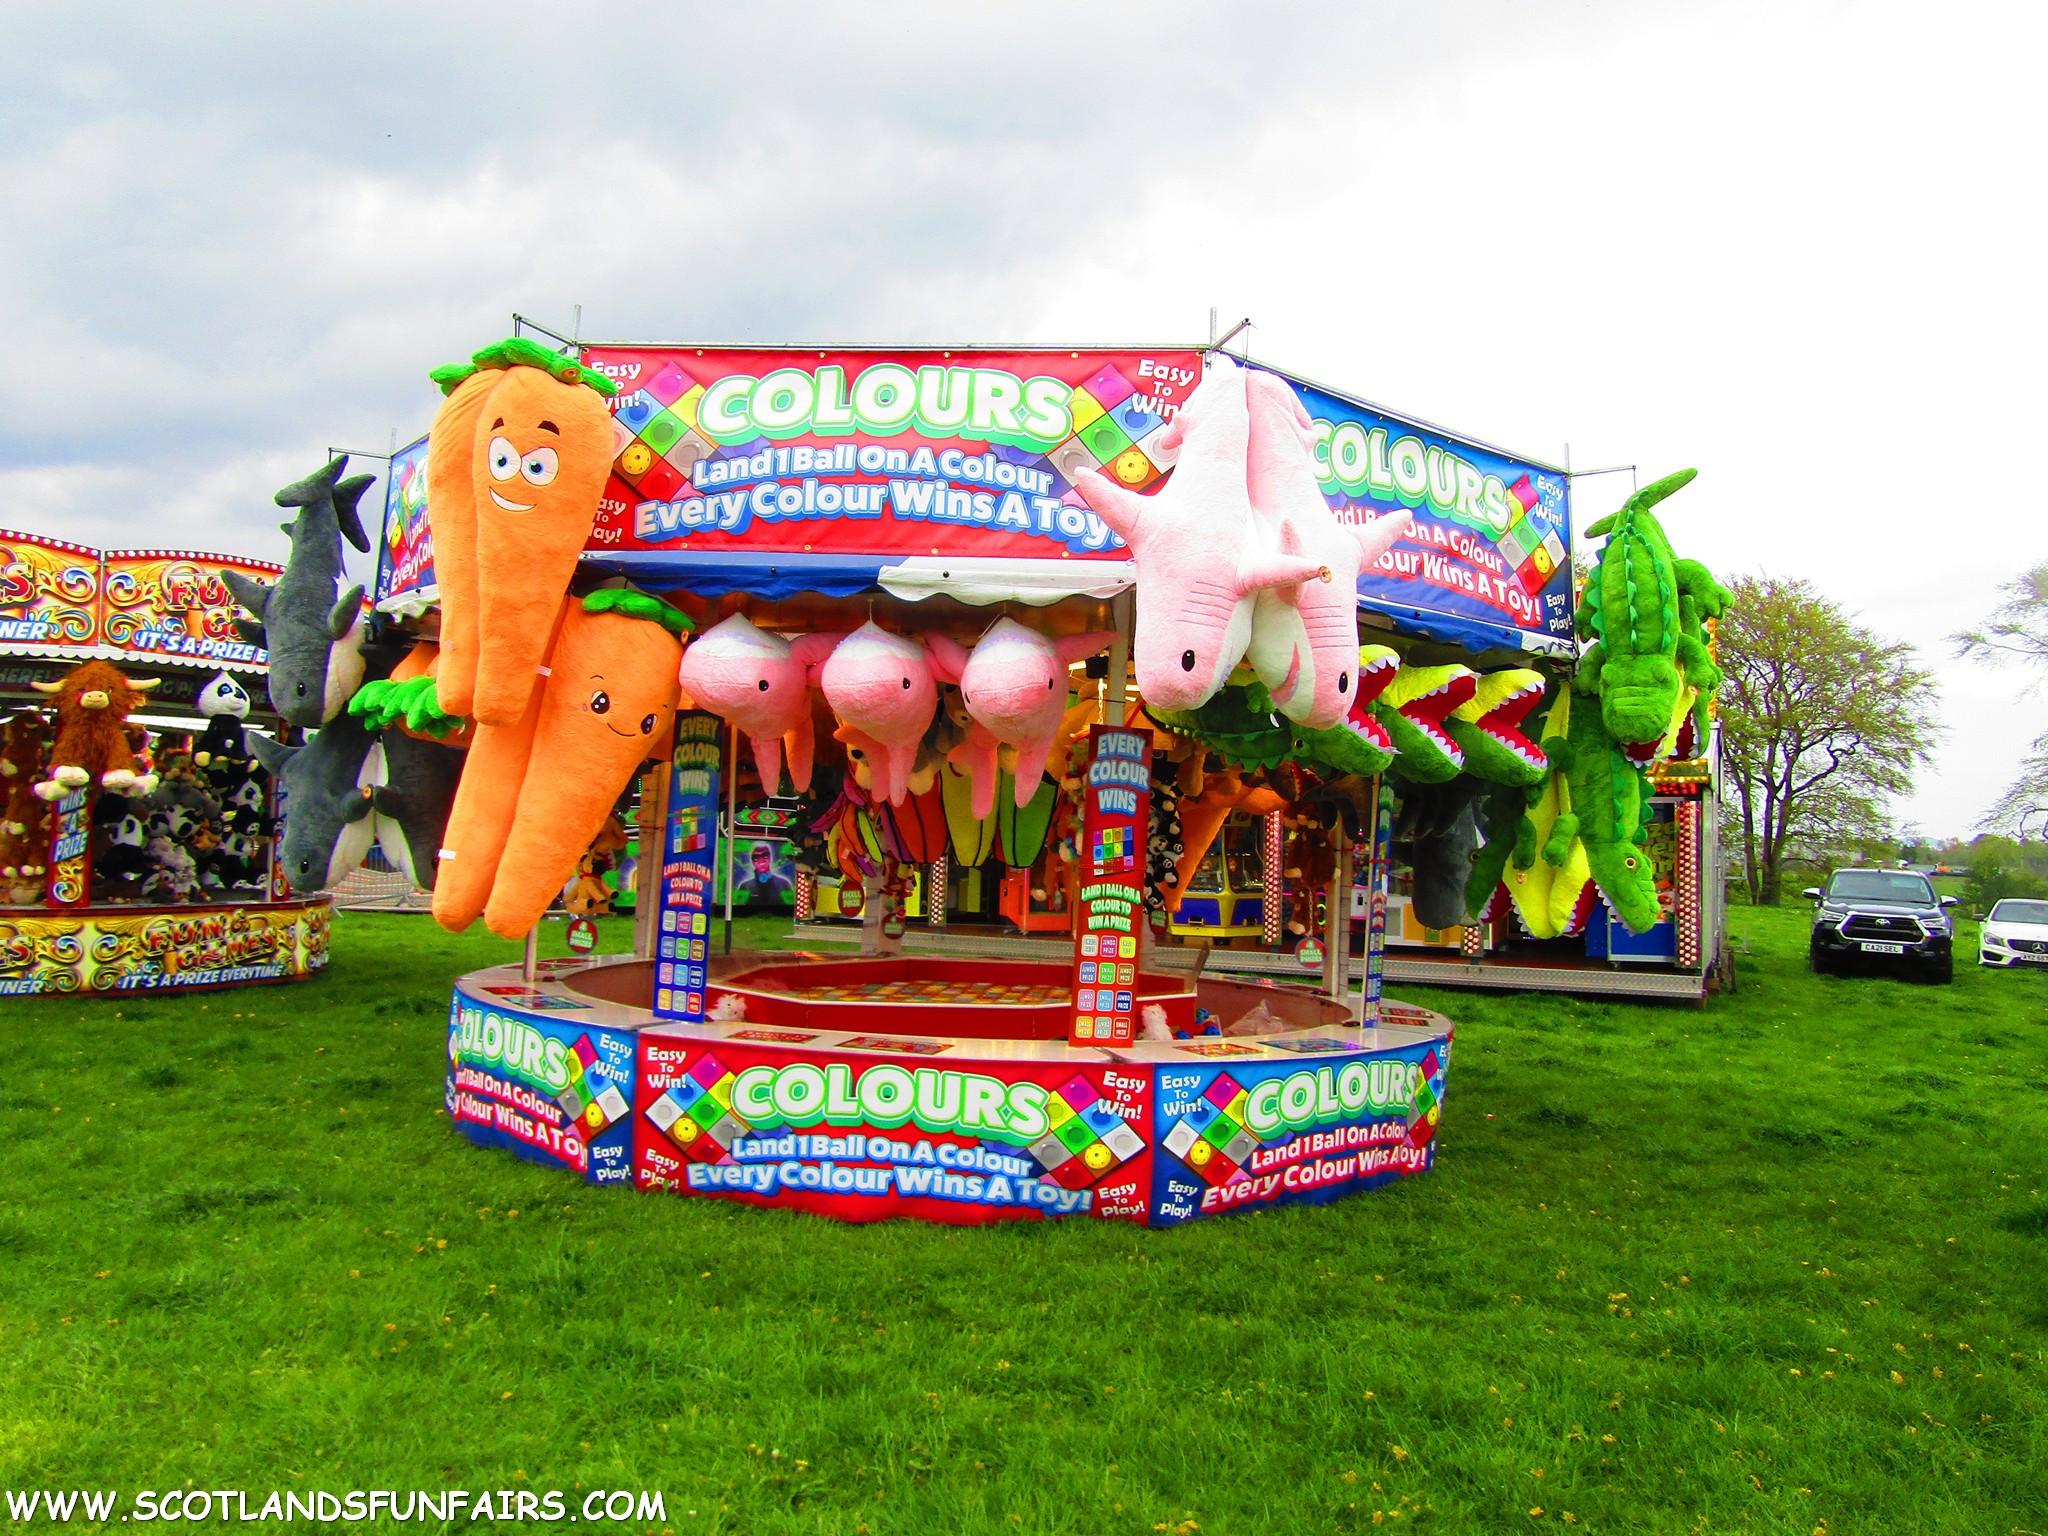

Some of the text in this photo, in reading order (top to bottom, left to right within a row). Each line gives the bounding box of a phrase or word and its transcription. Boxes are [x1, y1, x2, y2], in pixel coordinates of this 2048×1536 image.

[1138, 359, 1194, 387] Easy
[1153, 381, 1172, 396] To
[698, 363, 1073, 442] COLOURS
[1132, 393, 1184, 417] Win
[695, 445, 1053, 496] Land 1 Ball On A Colour
[1312, 419, 1510, 535] COLOURS
[1537, 475, 1563, 501] Easy
[600, 498, 626, 515] asy
[635, 478, 1030, 537] Every Colour Wins A
[1545, 495, 1555, 507] To
[1536, 501, 1563, 527] Win!
[1433, 524, 1448, 547] A
[1450, 531, 1503, 573] Colour
[391, 556, 419, 593] Every
[167, 574, 236, 612] FU
[1421, 551, 1542, 622] Wins A Toy!
[1546, 593, 1565, 607] Easy
[1554, 606, 1562, 616] To
[1550, 614, 1573, 632] Play!
[138, 630, 185, 651] IT'S
[184, 639, 198, 654] A
[199, 642, 254, 662] PRIZE
[680, 715, 719, 741] EVERY
[674, 742, 721, 770] COLOUR
[1097, 733, 1146, 759] EVERY
[679, 770, 711, 796] WINS
[1089, 760, 1149, 791] COLOUR
[1098, 788, 1137, 816] WINS
[69, 813, 79, 833] A
[55, 832, 89, 862] PRIZE
[671, 877, 703, 892] COLOUR TO
[1082, 884, 1101, 901] LAND
[1106, 884, 1123, 897] BALL
[1123, 886, 1135, 900] ON
[1135, 890, 1141, 904] A
[686, 893, 702, 908] PRIZE
[1091, 899, 1131, 915] COLOUR TO
[148, 913, 226, 956] FUN
[1088, 915, 1131, 932] WIN A PRIZE
[176, 928, 278, 973] GAMES
[1300, 948, 1322, 956] SMALL
[121, 965, 283, 990] IT'S A PRIZE EVERYTIME
[600, 1033, 632, 1058] Easy
[647, 1047, 686, 1063] Easy
[609, 1053, 620, 1065] To
[659, 1063, 674, 1073] To
[595, 1060, 630, 1083] Win!
[647, 1074, 687, 1089] Win!
[1102, 1070, 1146, 1094] Easy
[1161, 1075, 1201, 1090] Easy
[485, 1075, 501, 1096] On
[502, 1081, 512, 1100] A
[513, 1089, 562, 1123] Colour
[732, 1063, 1049, 1137] COLOURS
[1116, 1090, 1131, 1103] To
[1174, 1090, 1188, 1099] To
[1244, 1061, 1418, 1132] COLOURS
[461, 1092, 493, 1121] Colour
[494, 1102, 534, 1137] Wins
[536, 1124, 550, 1145] A
[1097, 1098, 1142, 1120] Win!
[1163, 1098, 1202, 1116] Win!
[593, 1146, 623, 1159] Easy
[732, 1134, 1033, 1177] Land 1 Ball On A Colour
[1252, 1121, 1407, 1170] Land 1 Ball On A Colou
[604, 1158, 616, 1167] To
[646, 1149, 679, 1170] Easy
[655, 1164, 667, 1175] To
[596, 1165, 631, 1182] Play!
[1202, 1174, 1281, 1208] Every
[1284, 1157, 1357, 1187] Colour
[688, 1161, 1092, 1211] Every Colour Wins A Toy!
[1098, 1183, 1136, 1199] Easy
[1168, 1180, 1198, 1196] Easy
[1101, 1201, 1145, 1217] Play!
[1113, 1196, 1127, 1205] To
[1174, 1194, 1184, 1203] To
[1160, 1203, 1192, 1218] Play!
